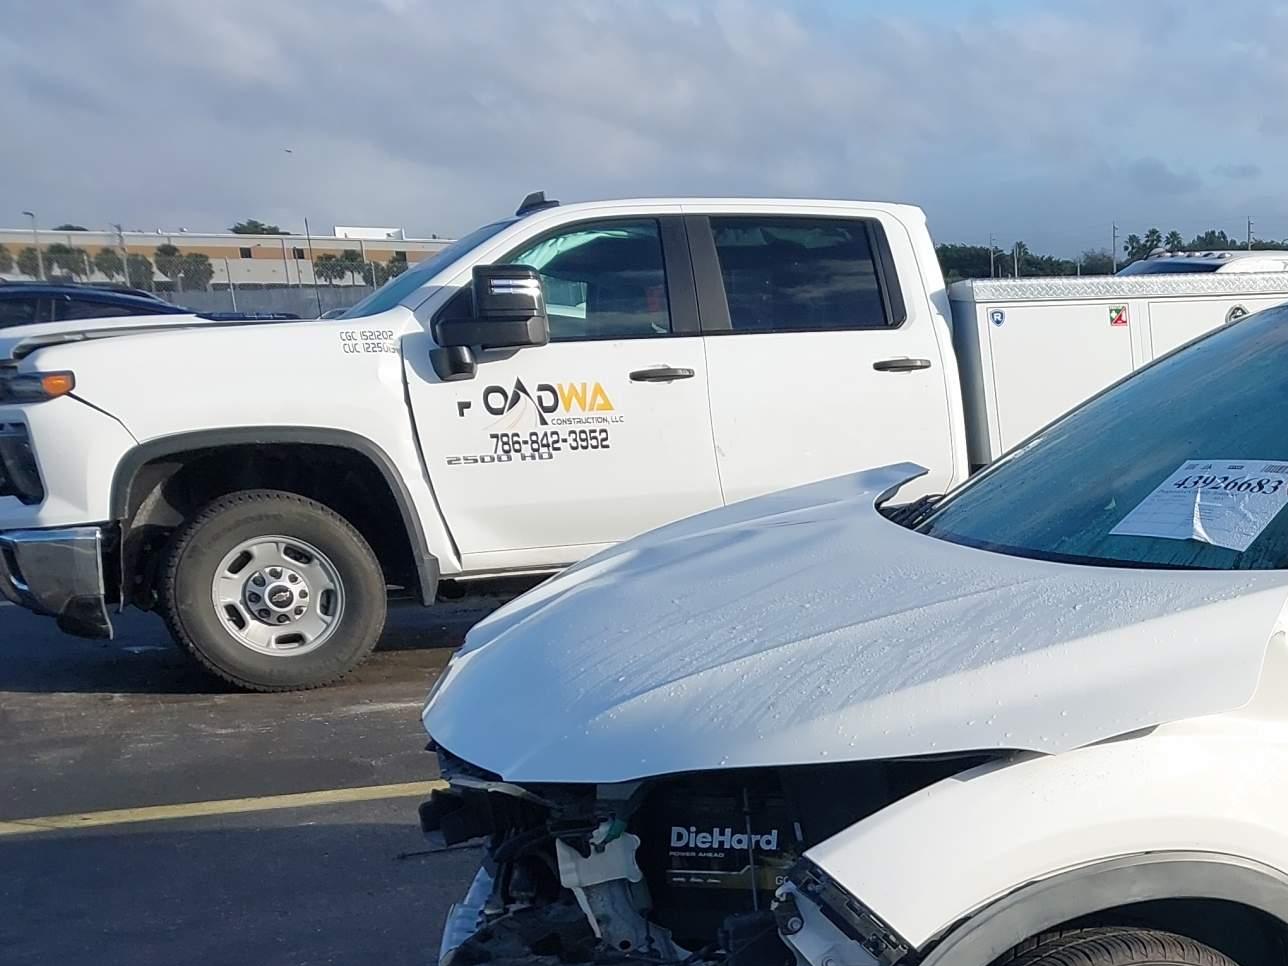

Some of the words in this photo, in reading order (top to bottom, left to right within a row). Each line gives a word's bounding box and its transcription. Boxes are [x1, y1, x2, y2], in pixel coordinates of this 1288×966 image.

[339, 331, 358, 341] CGC
[359, 330, 394, 341] 1521202
[342, 343, 361, 353] CUC
[550, 416, 610, 426] CONSTRUCTION,
[611, 415, 624, 423] LLC
[489, 428, 610, 454] 786-842-3952
[446, 453, 512, 465] 2500
[520, 451, 553, 462] HD
[1173, 475, 1284, 495] 43926683
[670, 826, 778, 850] DieHard
